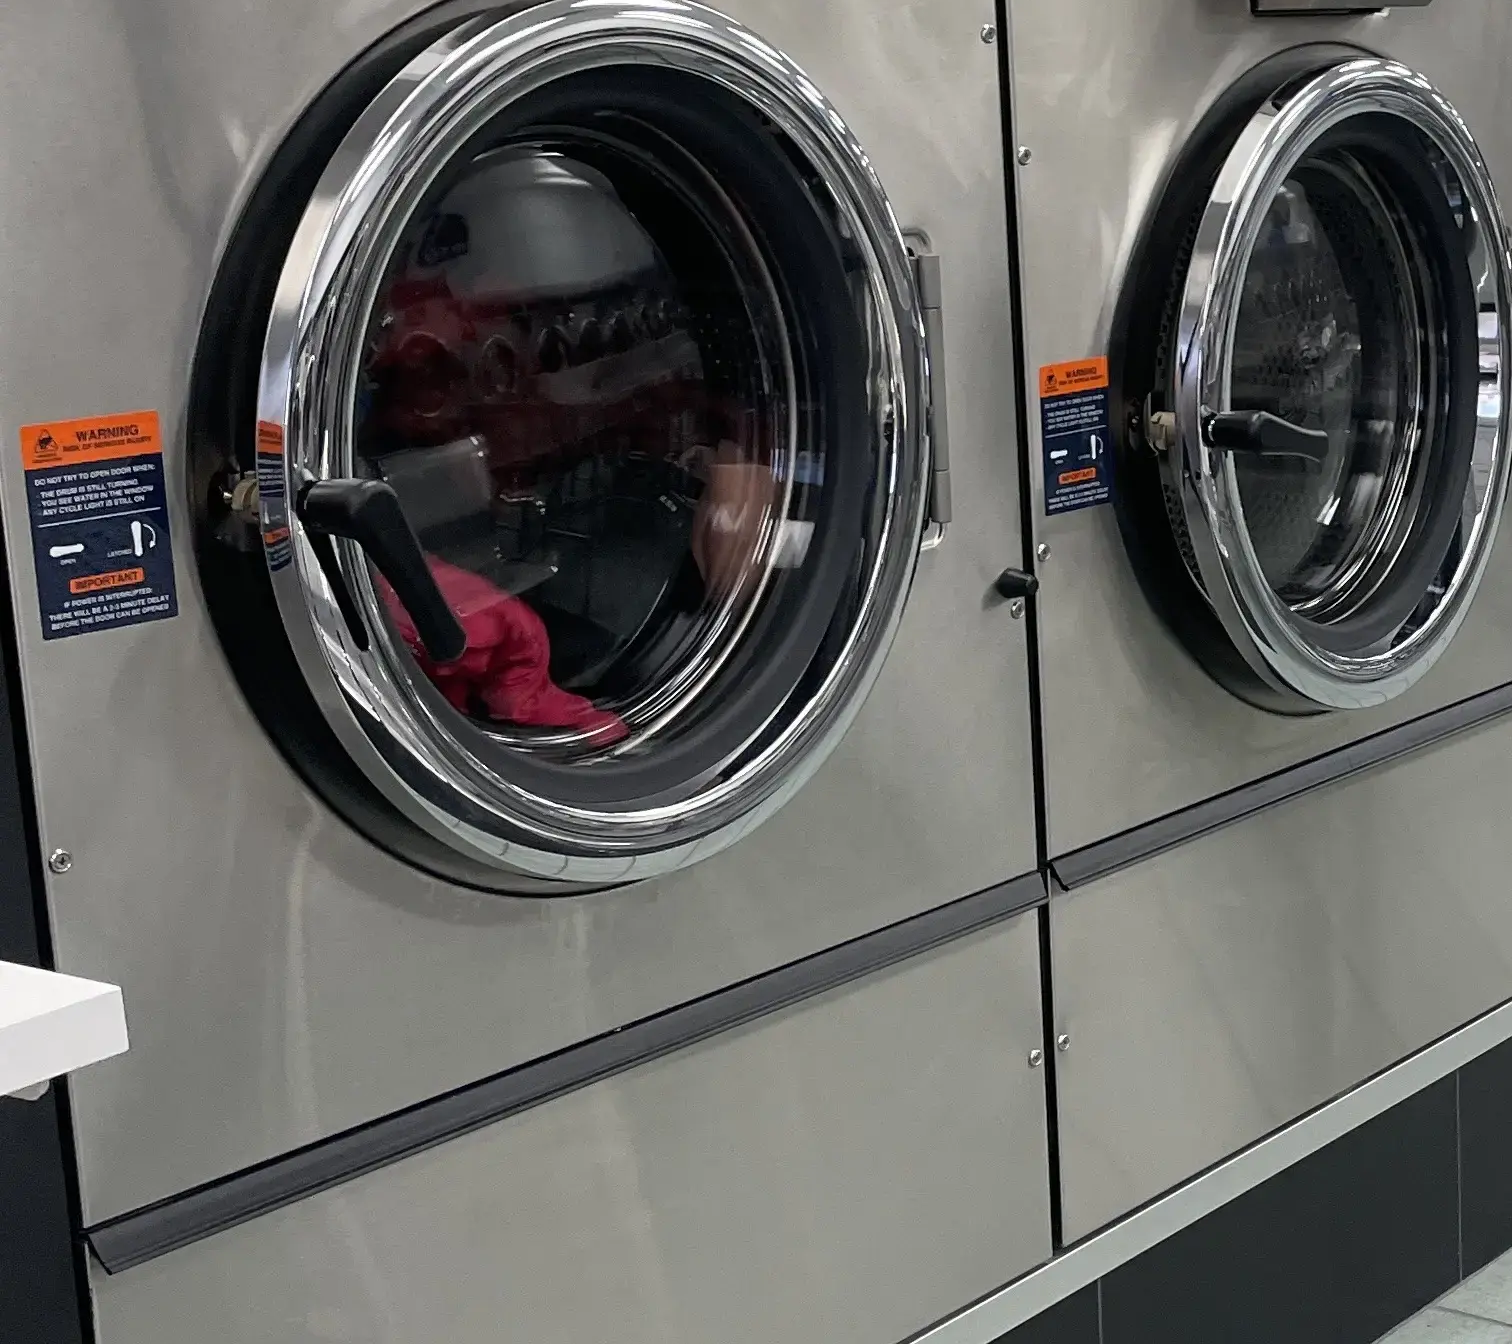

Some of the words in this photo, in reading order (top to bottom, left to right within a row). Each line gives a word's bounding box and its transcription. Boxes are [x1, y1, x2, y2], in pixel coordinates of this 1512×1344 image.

[75, 424, 139, 442] WARNING
[46, 476, 62, 484] NOT
[63, 474, 77, 482] TRY
[90, 470, 110, 479] OPEN
[58, 504, 82, 514] CYCLE
[133, 495, 145, 503] ON
[75, 571, 138, 590] IMPORTANT
[146, 594, 170, 604] DELAY
